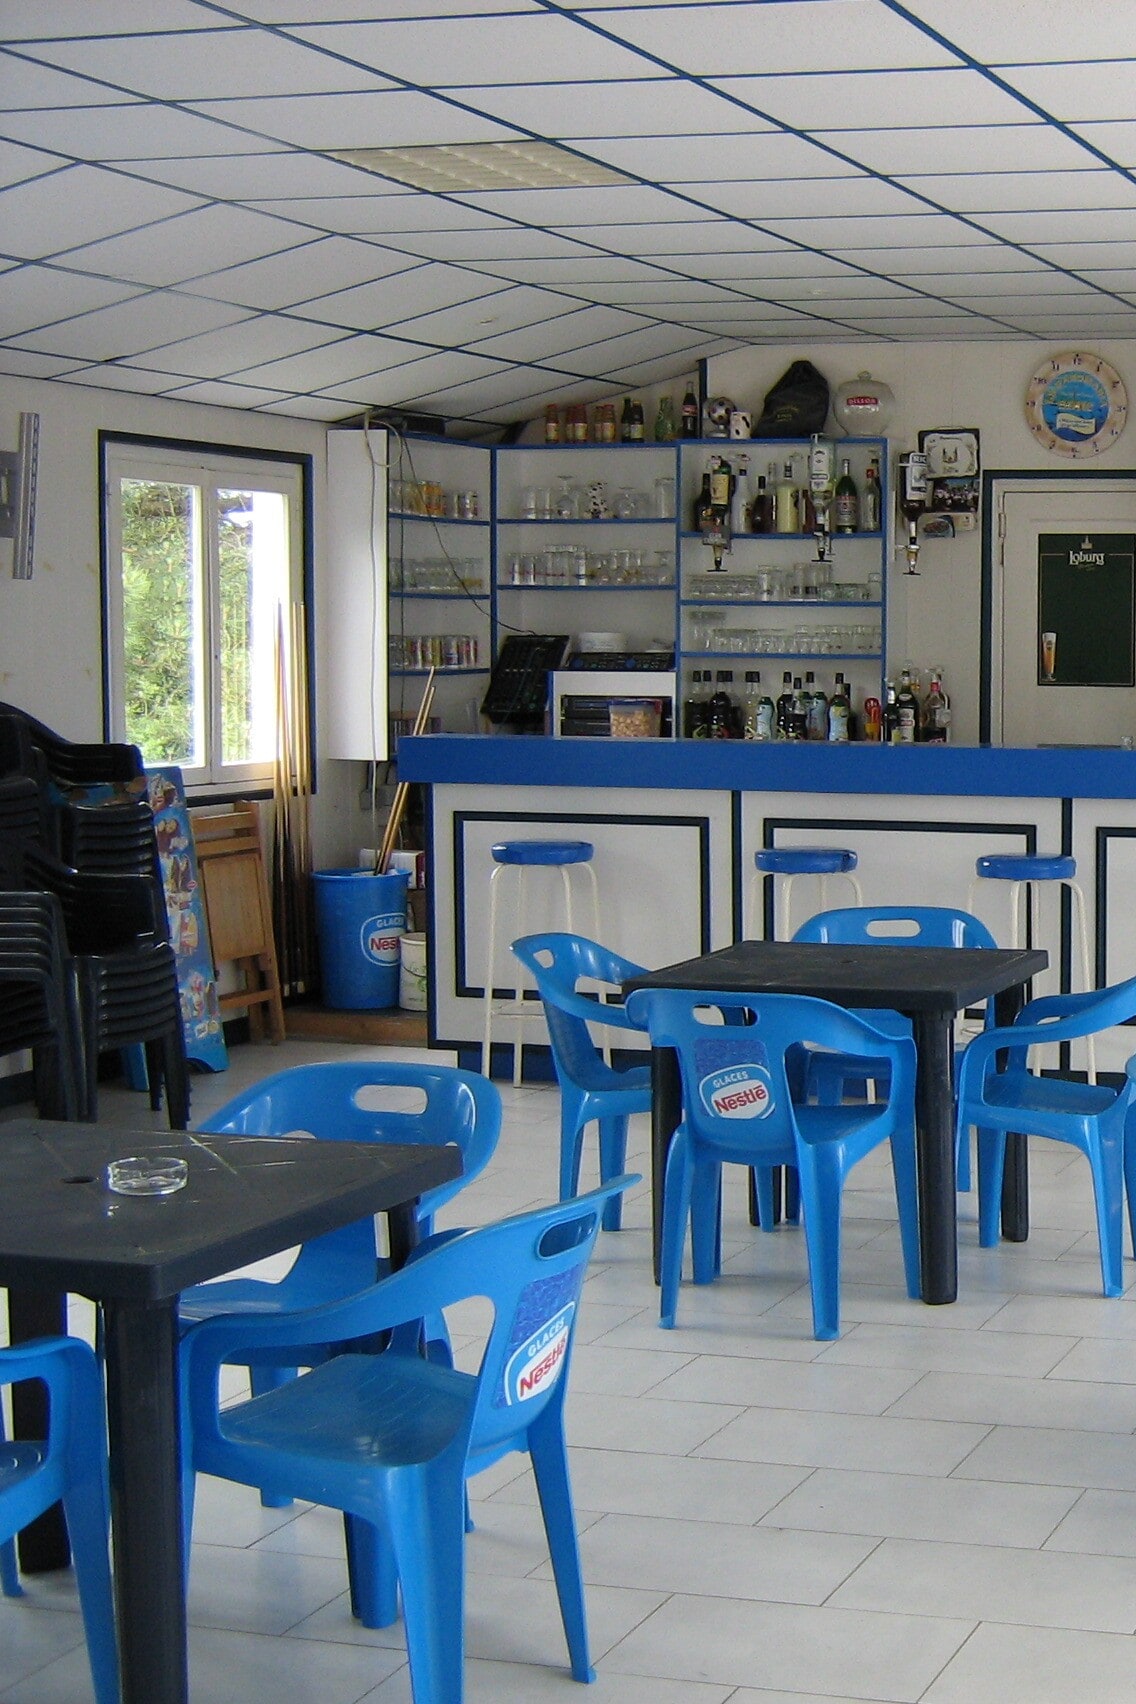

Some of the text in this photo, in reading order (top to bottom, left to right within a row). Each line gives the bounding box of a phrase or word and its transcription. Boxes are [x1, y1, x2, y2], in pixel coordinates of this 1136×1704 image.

[1069, 551, 1105, 566] Loburg
[712, 1070, 748, 1089] GLACES
[713, 1084, 767, 1114] Nestlé
